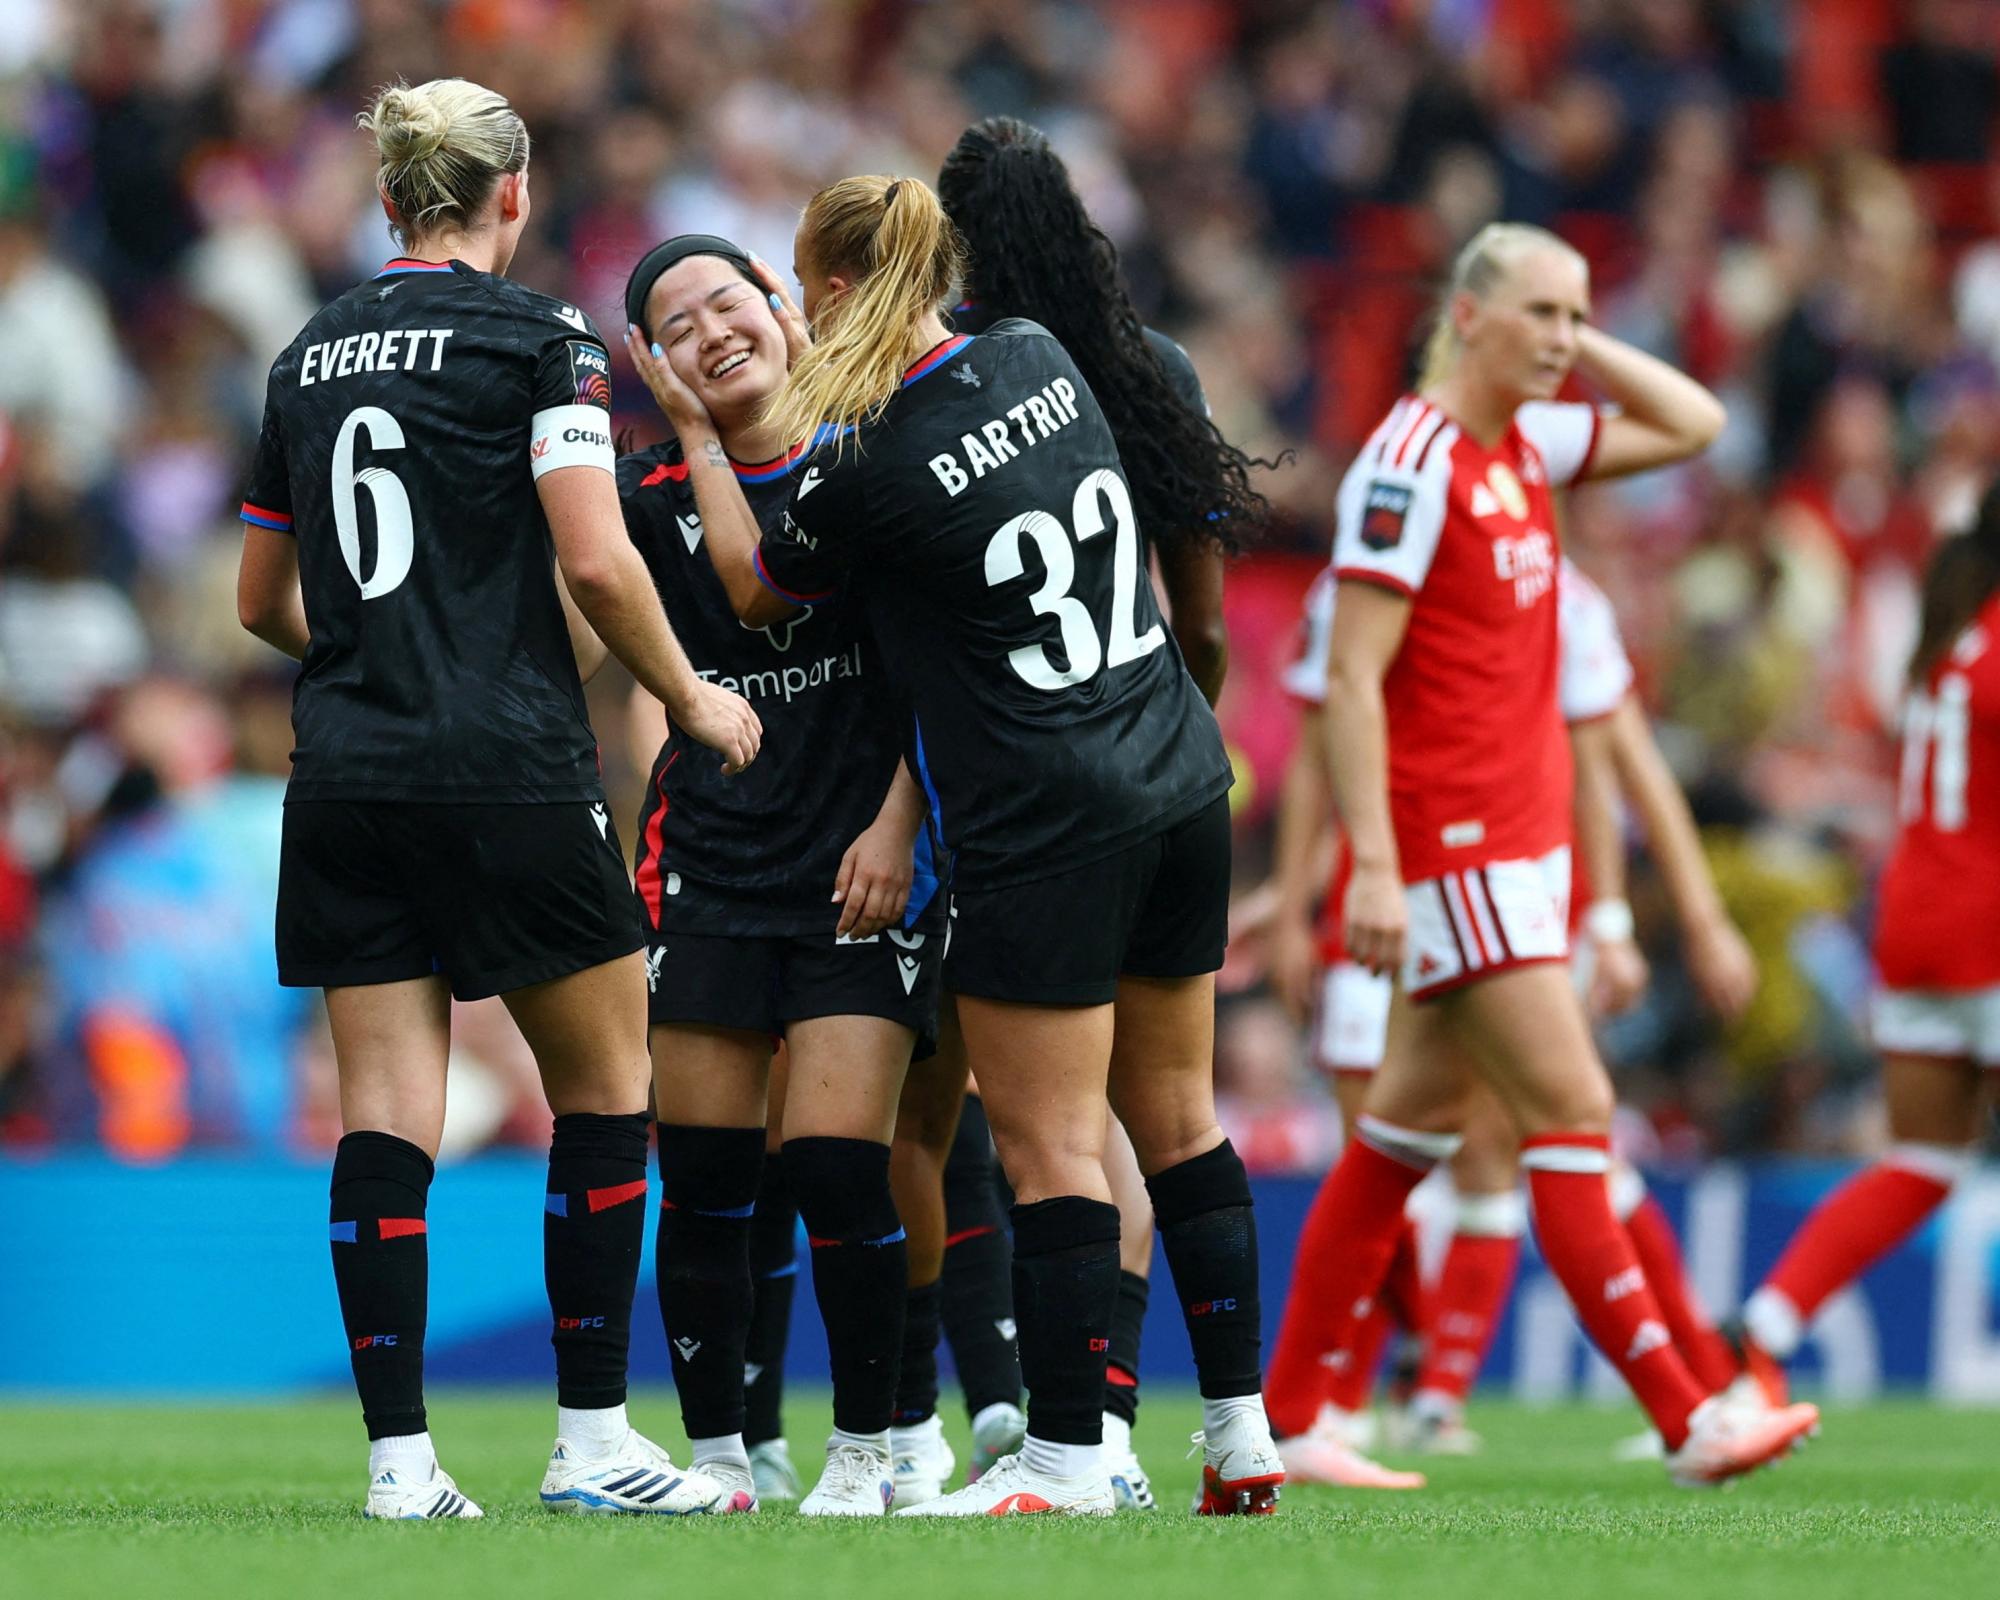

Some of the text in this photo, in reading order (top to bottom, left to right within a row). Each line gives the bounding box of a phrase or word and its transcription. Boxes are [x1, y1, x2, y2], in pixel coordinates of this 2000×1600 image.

[300, 329, 454, 388] EVERETT
[575, 352, 607, 374] WSL
[927, 377, 1080, 498] BARTRIP
[331, 406, 415, 601] 6
[984, 468, 1166, 690] 32
[355, 1334, 399, 1350] CPFC
[559, 1315, 606, 1330] CPFC
